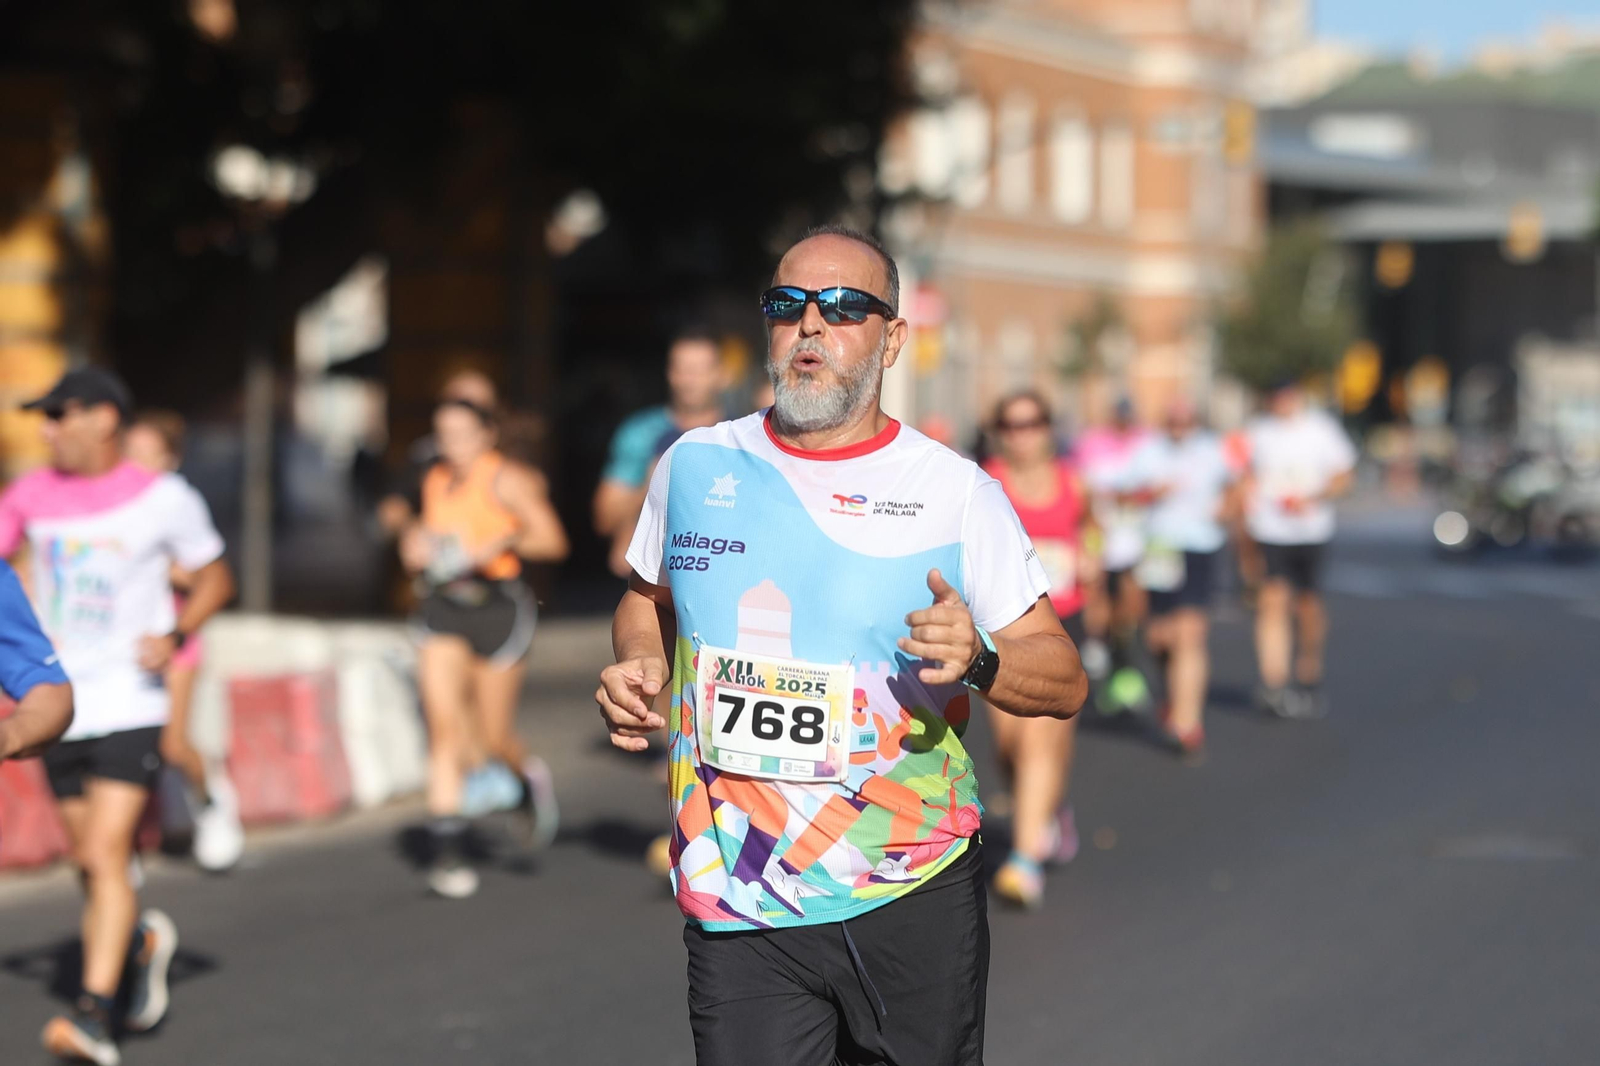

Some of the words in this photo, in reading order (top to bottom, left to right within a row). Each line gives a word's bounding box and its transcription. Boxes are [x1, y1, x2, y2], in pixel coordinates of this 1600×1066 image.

[704, 496, 736, 509] luanvi
[887, 500, 924, 510] MARATÓN
[671, 531, 746, 555] Málaga
[669, 555, 710, 571] 2025
[777, 665, 804, 674] CARRERA
[740, 674, 765, 688] 10k
[775, 677, 826, 695] 2025
[718, 693, 825, 745] 768
